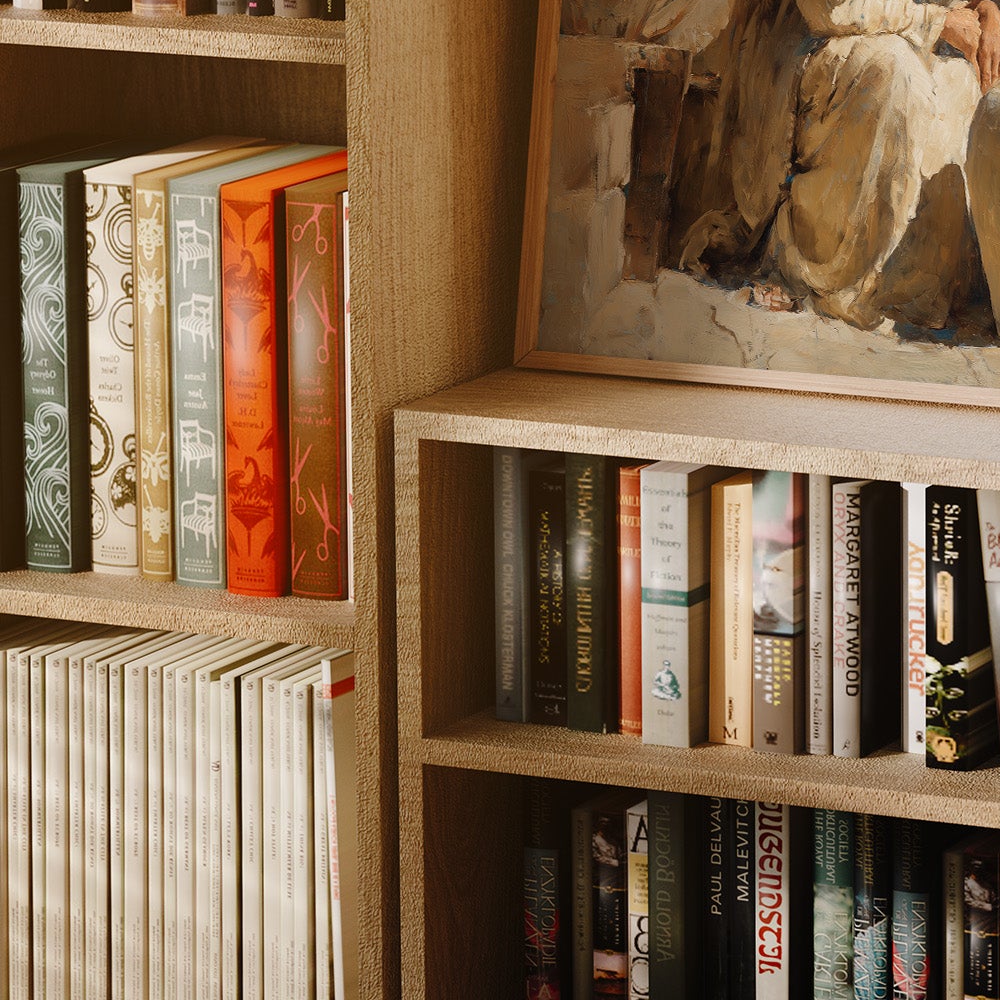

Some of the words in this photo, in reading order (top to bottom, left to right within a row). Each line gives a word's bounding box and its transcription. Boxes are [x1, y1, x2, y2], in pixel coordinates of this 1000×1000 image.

[501, 455, 513, 528] DOWNTOWN
[834, 492, 845, 544] ORYX
[502, 530, 513, 558] OWL
[651, 537, 682, 549] Theory
[846, 493, 860, 605] MARGARET
[502, 563, 514, 606] CHUCK
[502, 609, 514, 691] KLOSTERMAN
[834, 600, 845, 670] CRAKE
[846, 611, 860, 697] ATWOOD
[711, 797, 722, 865] DELVAU
[711, 871, 722, 916] PAUL
